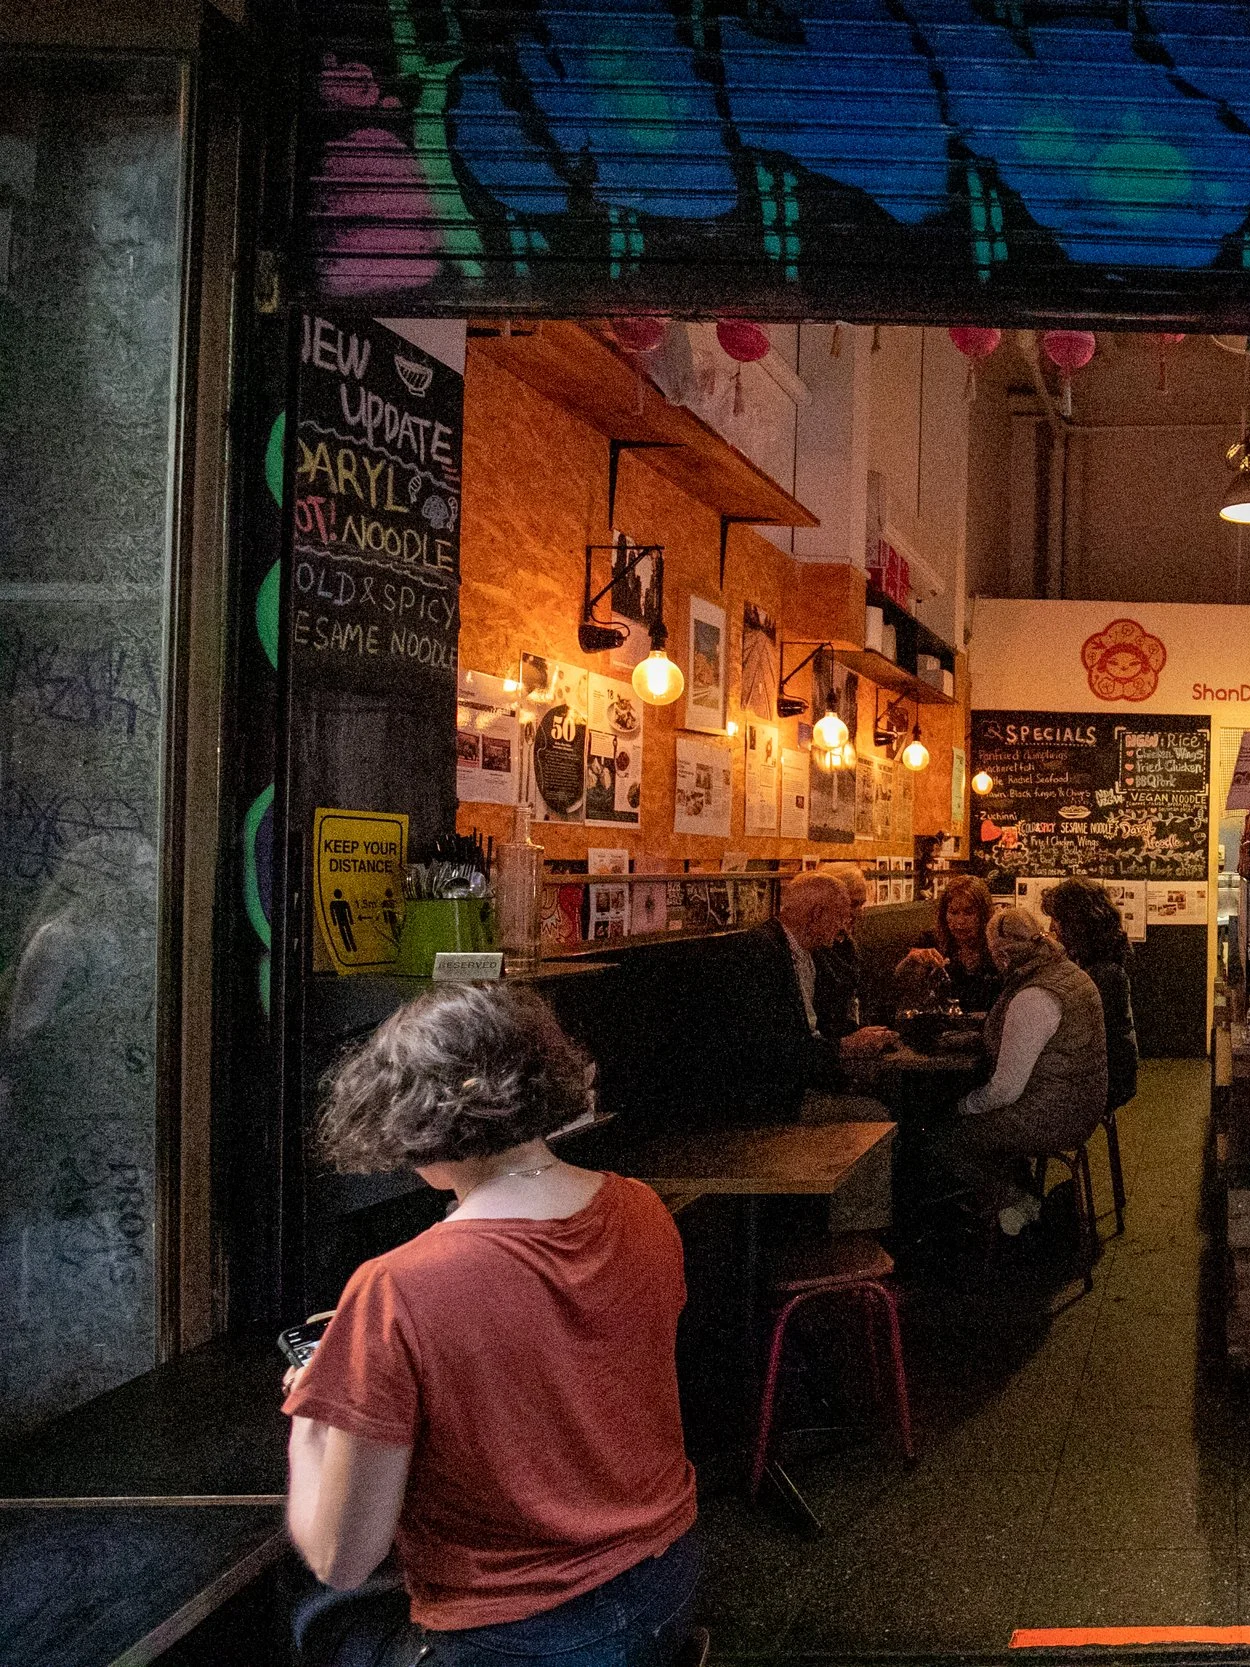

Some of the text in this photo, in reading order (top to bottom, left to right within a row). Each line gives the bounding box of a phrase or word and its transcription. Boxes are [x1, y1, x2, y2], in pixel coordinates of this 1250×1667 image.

[340, 383, 452, 465] UPDATE
[342, 516, 453, 573] NOODLE
[383, 583, 457, 630] SPICY
[607, 689, 614, 699] 18
[550, 715, 576, 742] 50
[1006, 724, 1097, 744] SPECIALS
[1167, 733, 1201, 748] Rice
[1036, 771, 1069, 783] Seafood
[1009, 788, 1032, 799] Black
[1131, 793, 1170, 802] VEGAN
[1171, 794, 1207, 805] NOODLE
[1060, 821, 1089, 835] SESAME
[1090, 822, 1115, 835] NOODLE
[324, 839, 397, 856] KEEP YOUR
[1076, 835, 1099, 850] Wings
[329, 858, 393, 874] DISTANCE
[1031, 863, 1067, 876] Jasmine
[1068, 864, 1088, 875] Tea
[437, 961, 498, 969] RESERVED
